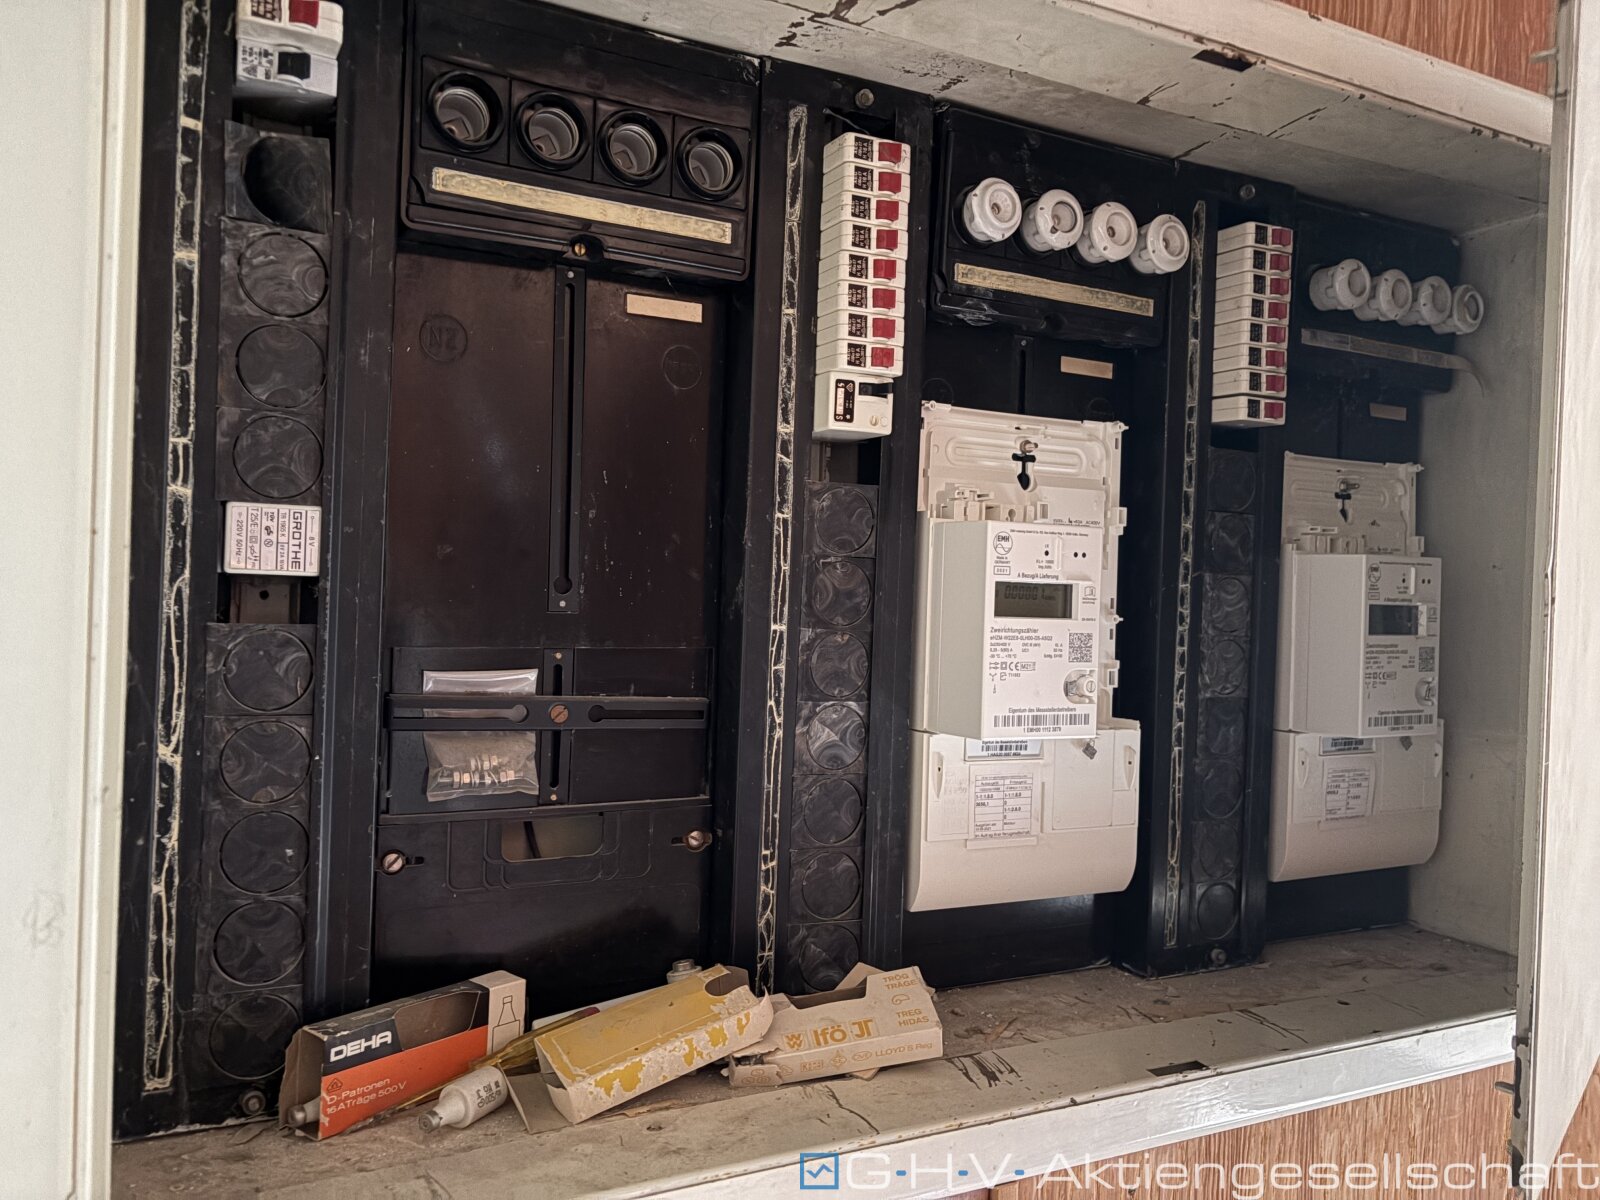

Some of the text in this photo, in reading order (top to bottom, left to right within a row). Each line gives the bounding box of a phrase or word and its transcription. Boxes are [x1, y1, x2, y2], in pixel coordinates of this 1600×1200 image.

[291, 511, 302, 570] GROTHE
[896, 1008, 922, 1018] TREG
[899, 1016, 929, 1026] HIDAS
[330, 1031, 392, 1062] DEHA
[327, 1078, 390, 1105] D-Patronen
